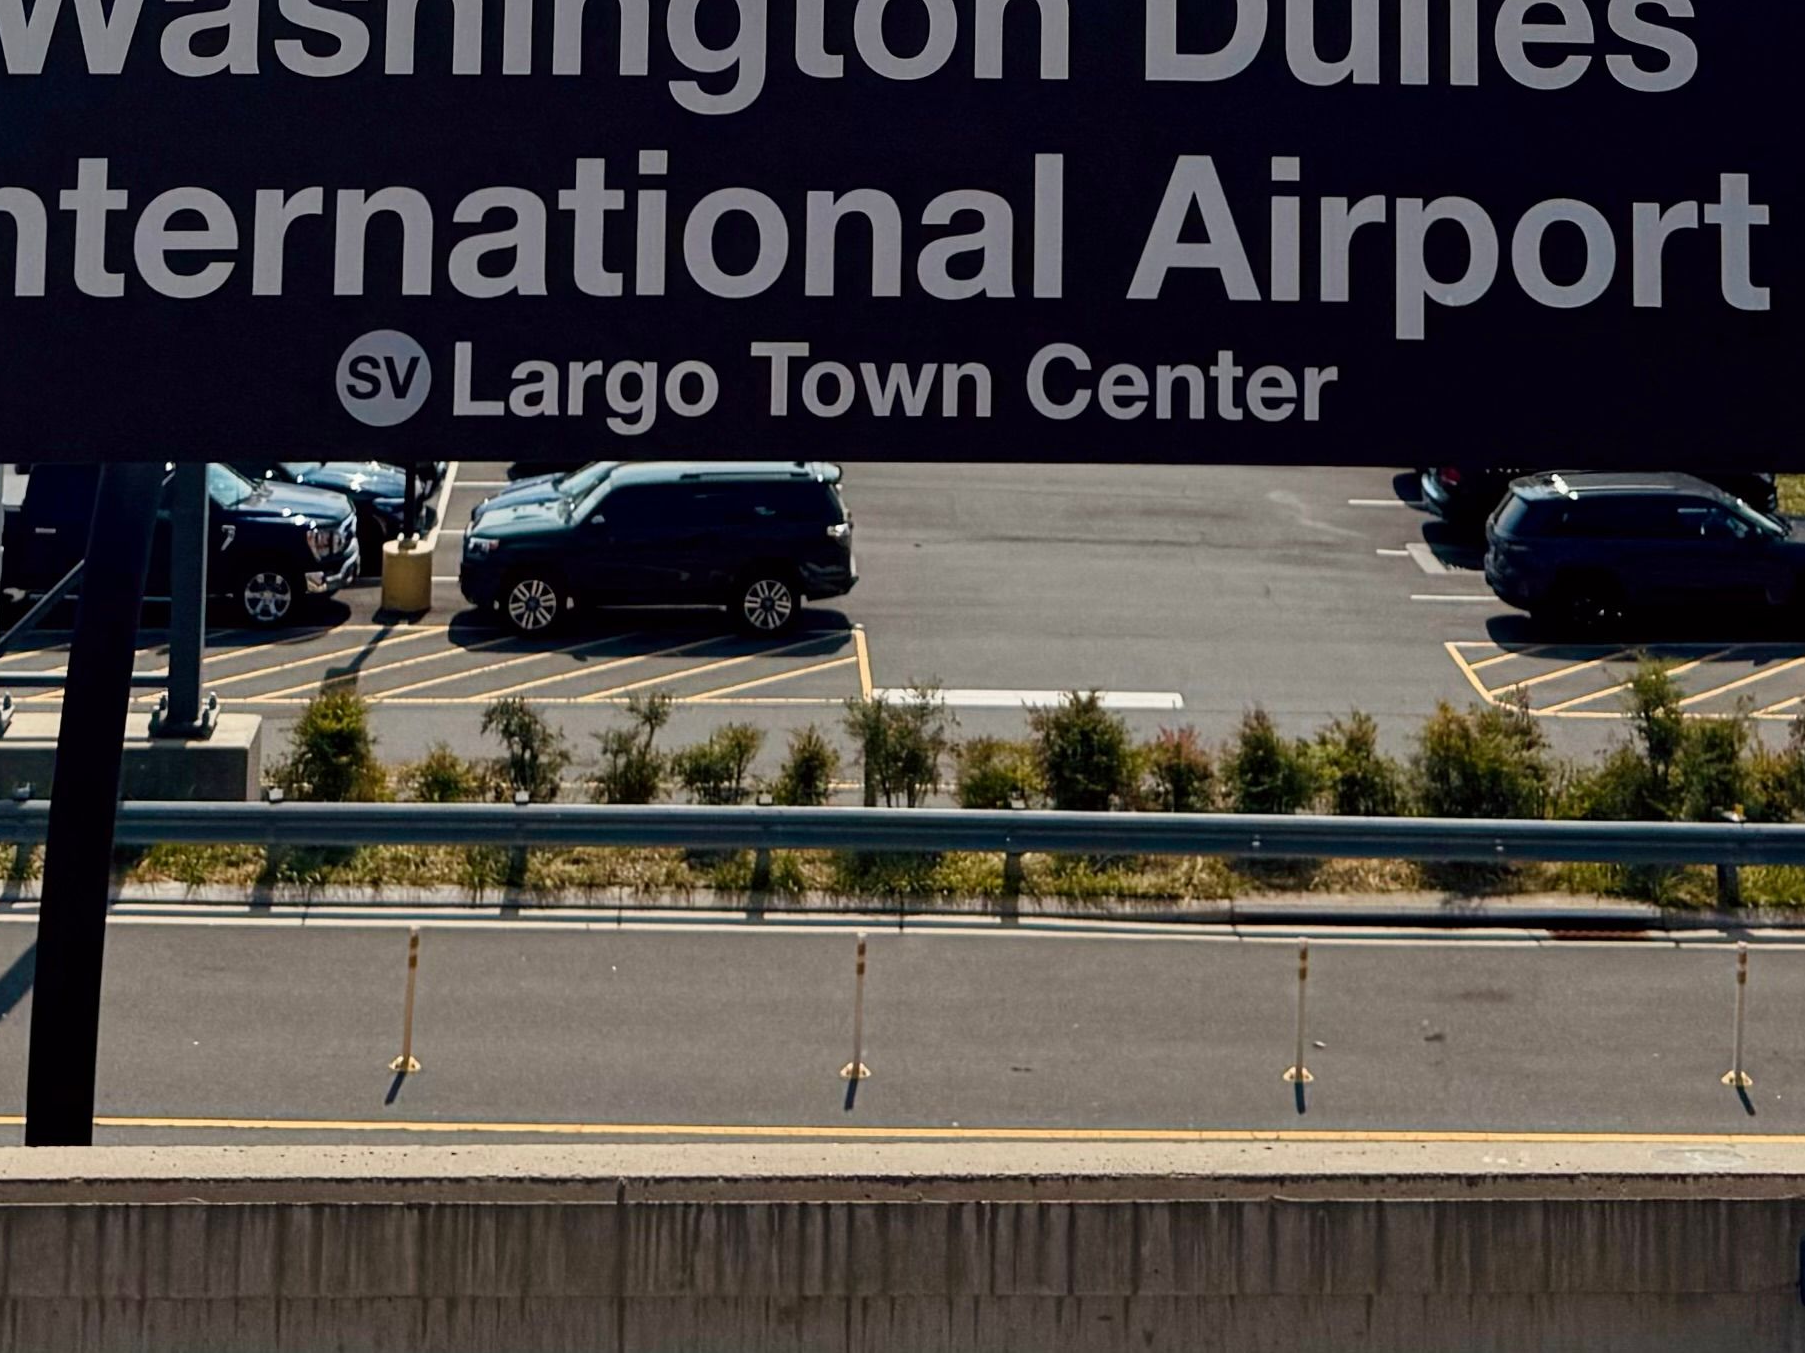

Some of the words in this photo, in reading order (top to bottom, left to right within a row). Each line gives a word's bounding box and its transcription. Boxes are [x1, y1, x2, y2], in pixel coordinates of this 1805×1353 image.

[1125, 154, 1771, 341] Airport
[346, 354, 421, 400] SV
[452, 341, 719, 436] Largo
[750, 341, 992, 418] Town
[1026, 342, 1339, 422] Center
